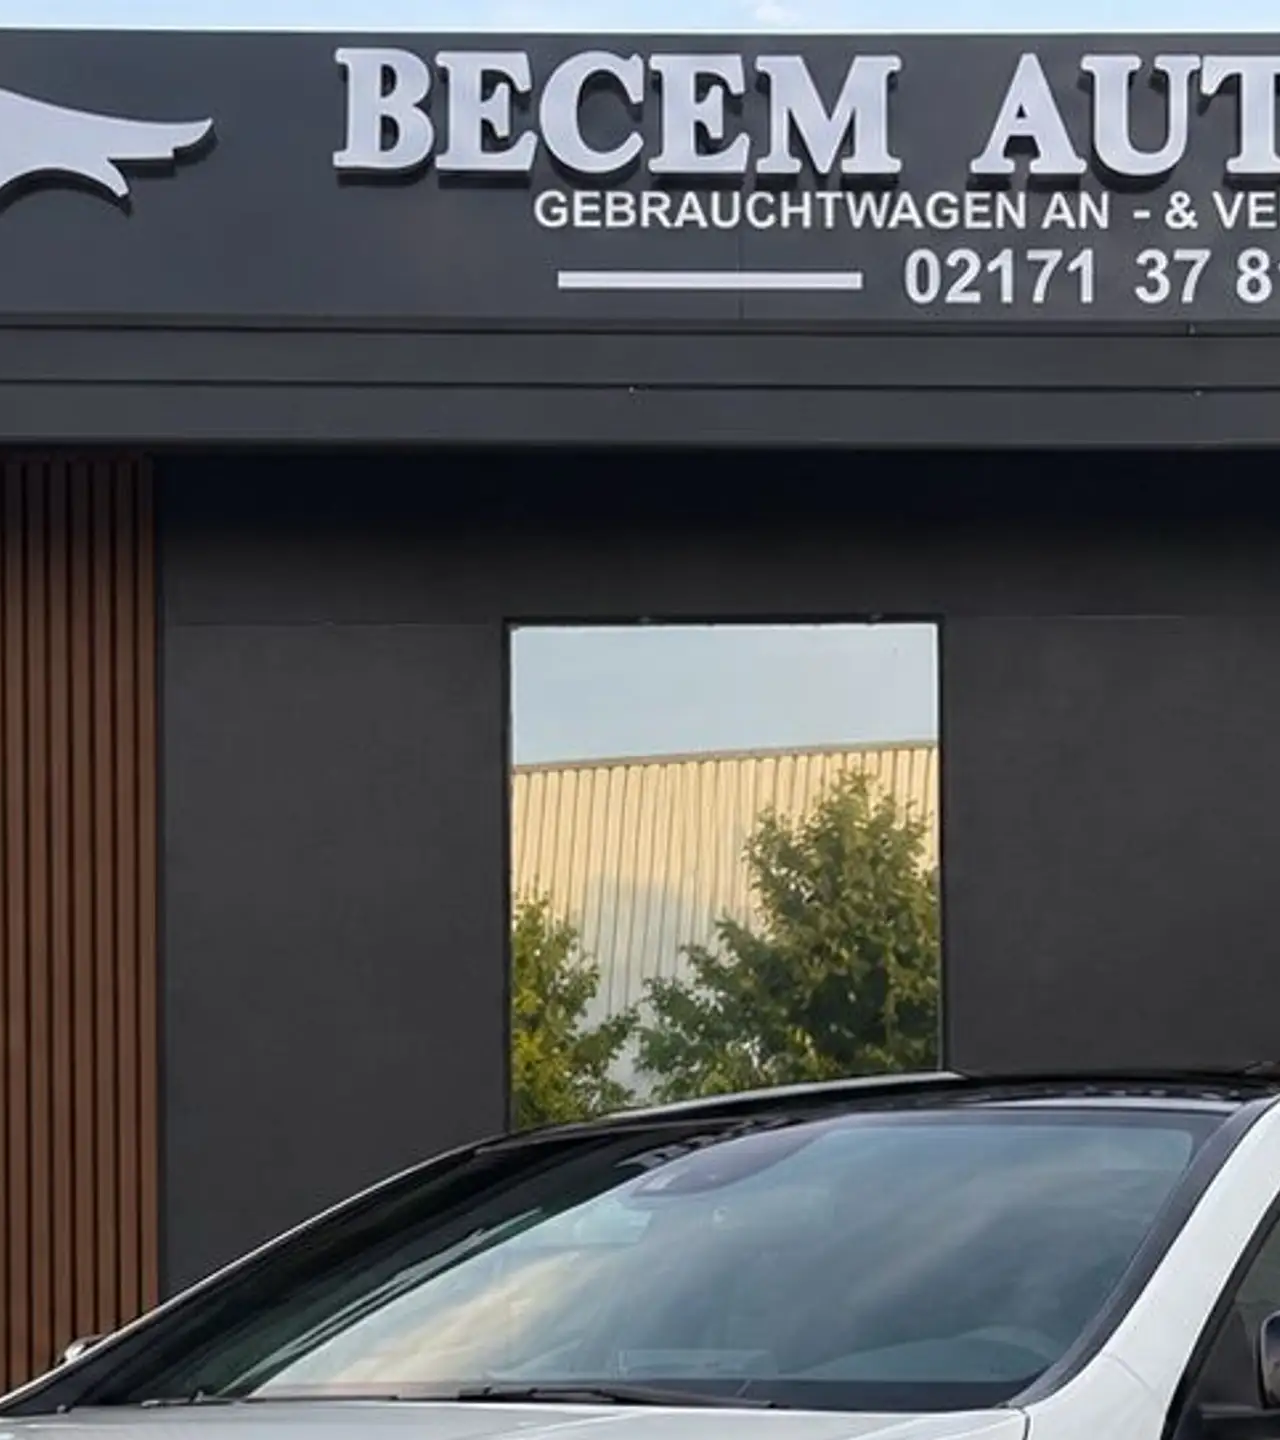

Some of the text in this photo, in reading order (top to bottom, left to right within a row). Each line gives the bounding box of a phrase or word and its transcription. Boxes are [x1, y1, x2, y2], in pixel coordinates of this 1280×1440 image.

[333, 47, 903, 175] BECEM
[534, 190, 1026, 230] GEBRAUCHTWAGEN
[1041, 191, 1110, 230] AN
[1165, 191, 1199, 230] &
[904, 247, 1095, 305] 02171
[1134, 247, 1213, 305] 37
